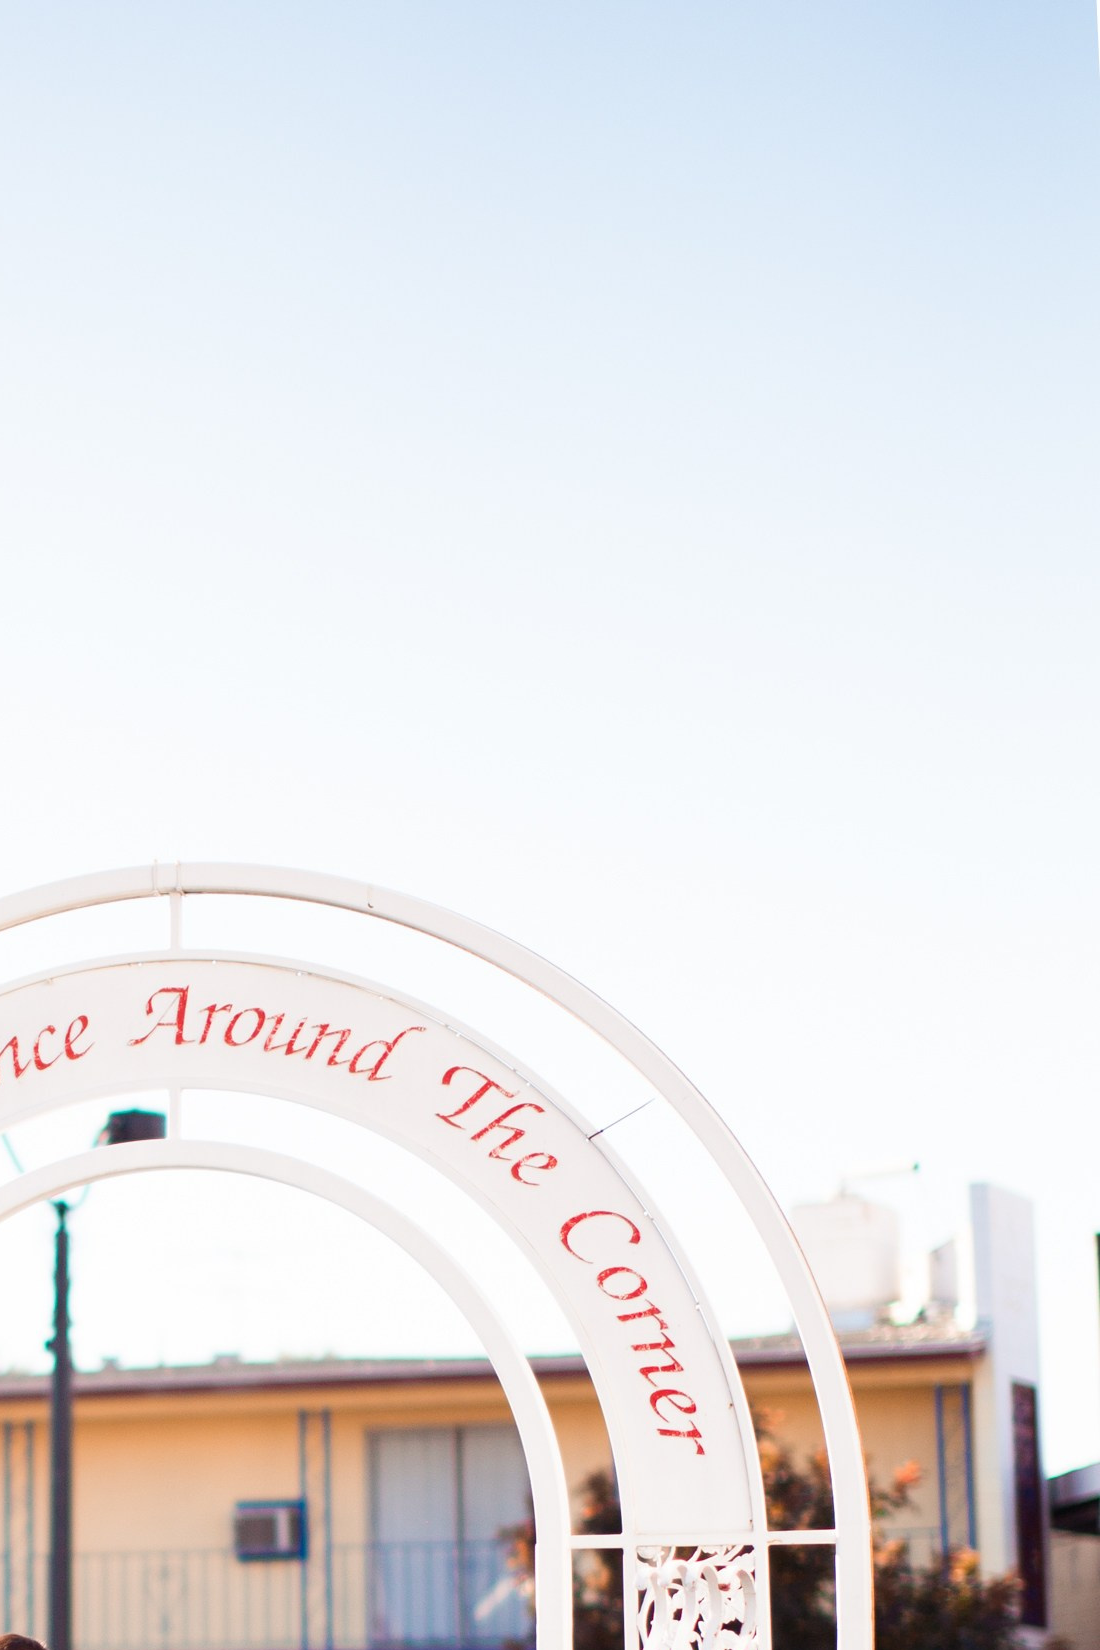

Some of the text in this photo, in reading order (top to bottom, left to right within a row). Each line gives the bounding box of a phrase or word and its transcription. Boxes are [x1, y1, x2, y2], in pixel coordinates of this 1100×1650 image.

[127, 984, 426, 1083] Around
[435, 1065, 558, 1186] The
[559, 1210, 706, 1456] Corner
